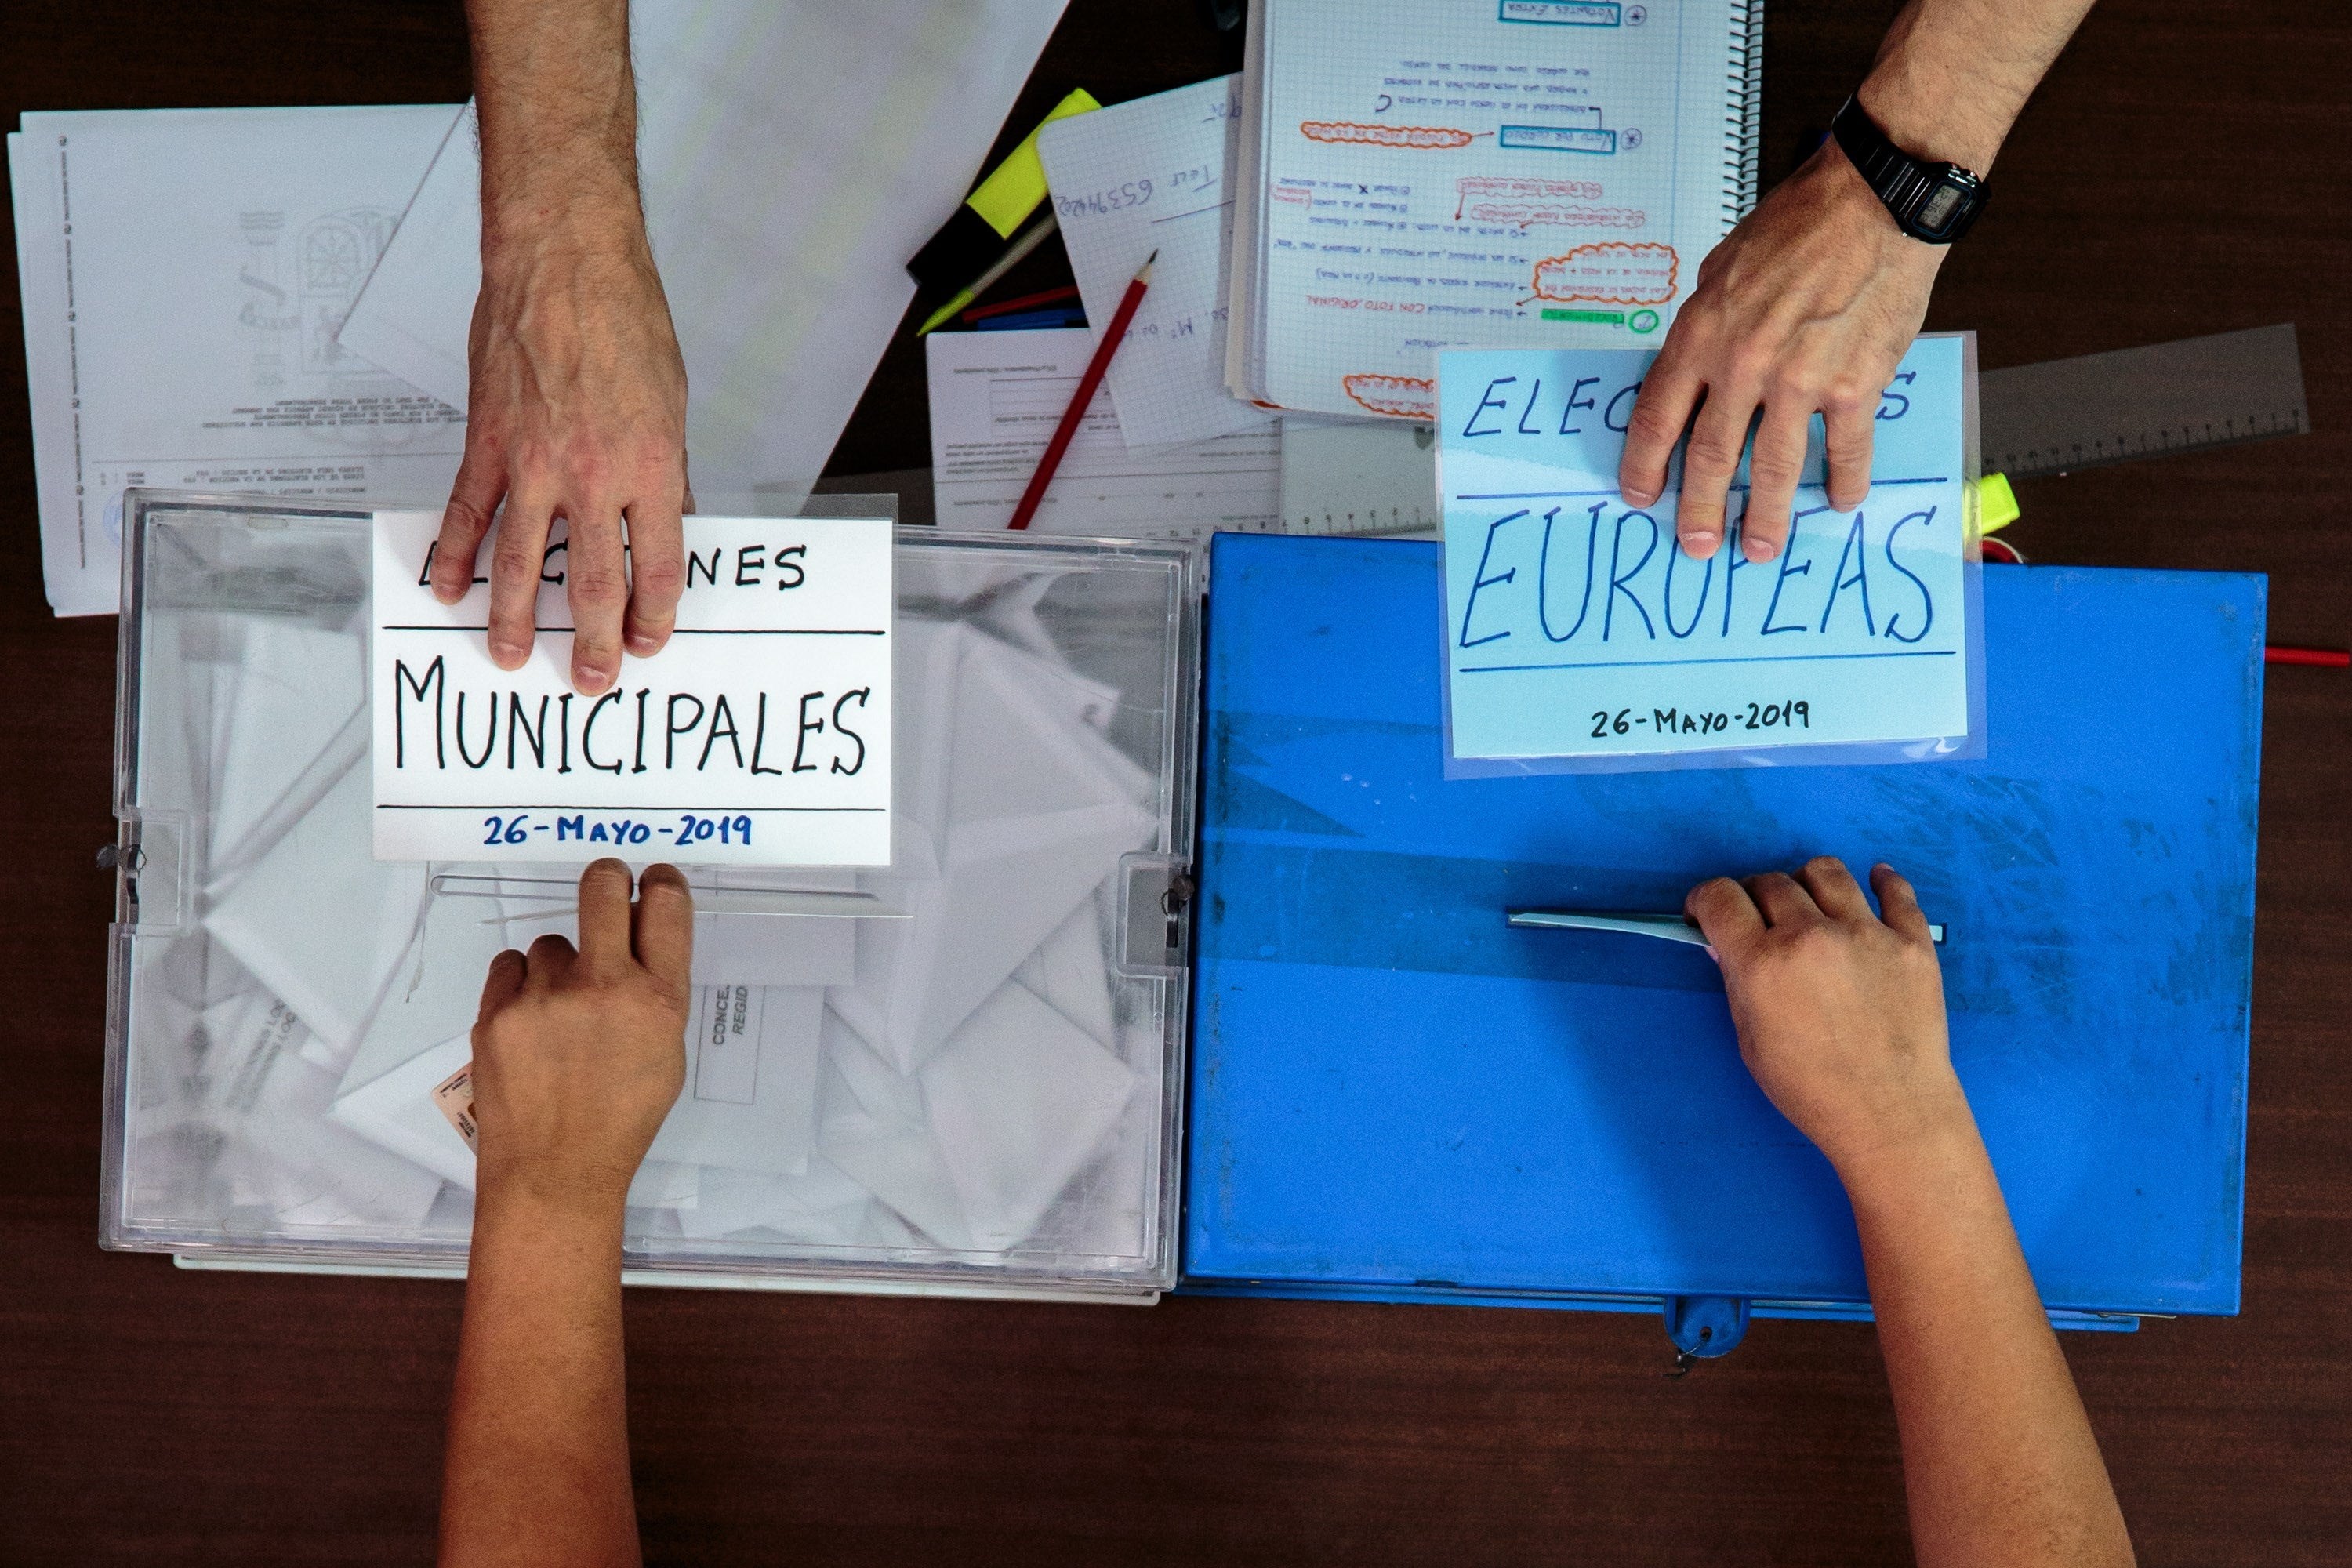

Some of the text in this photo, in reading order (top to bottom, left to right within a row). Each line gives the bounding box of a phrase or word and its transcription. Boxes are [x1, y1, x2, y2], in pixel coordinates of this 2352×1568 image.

[1375, 94, 1392, 112] C
[1305, 295, 1359, 310] ORIGINAL
[1364, 300, 1393, 312] FOTO
[1399, 303, 1425, 314] CON
[395, 655, 872, 776] MUNICIPALES
[1591, 700, 1810, 738] 26-MAYO-2019
[483, 814, 753, 846] 26-MAYO-2019
[712, 985, 731, 1045] CONCE
